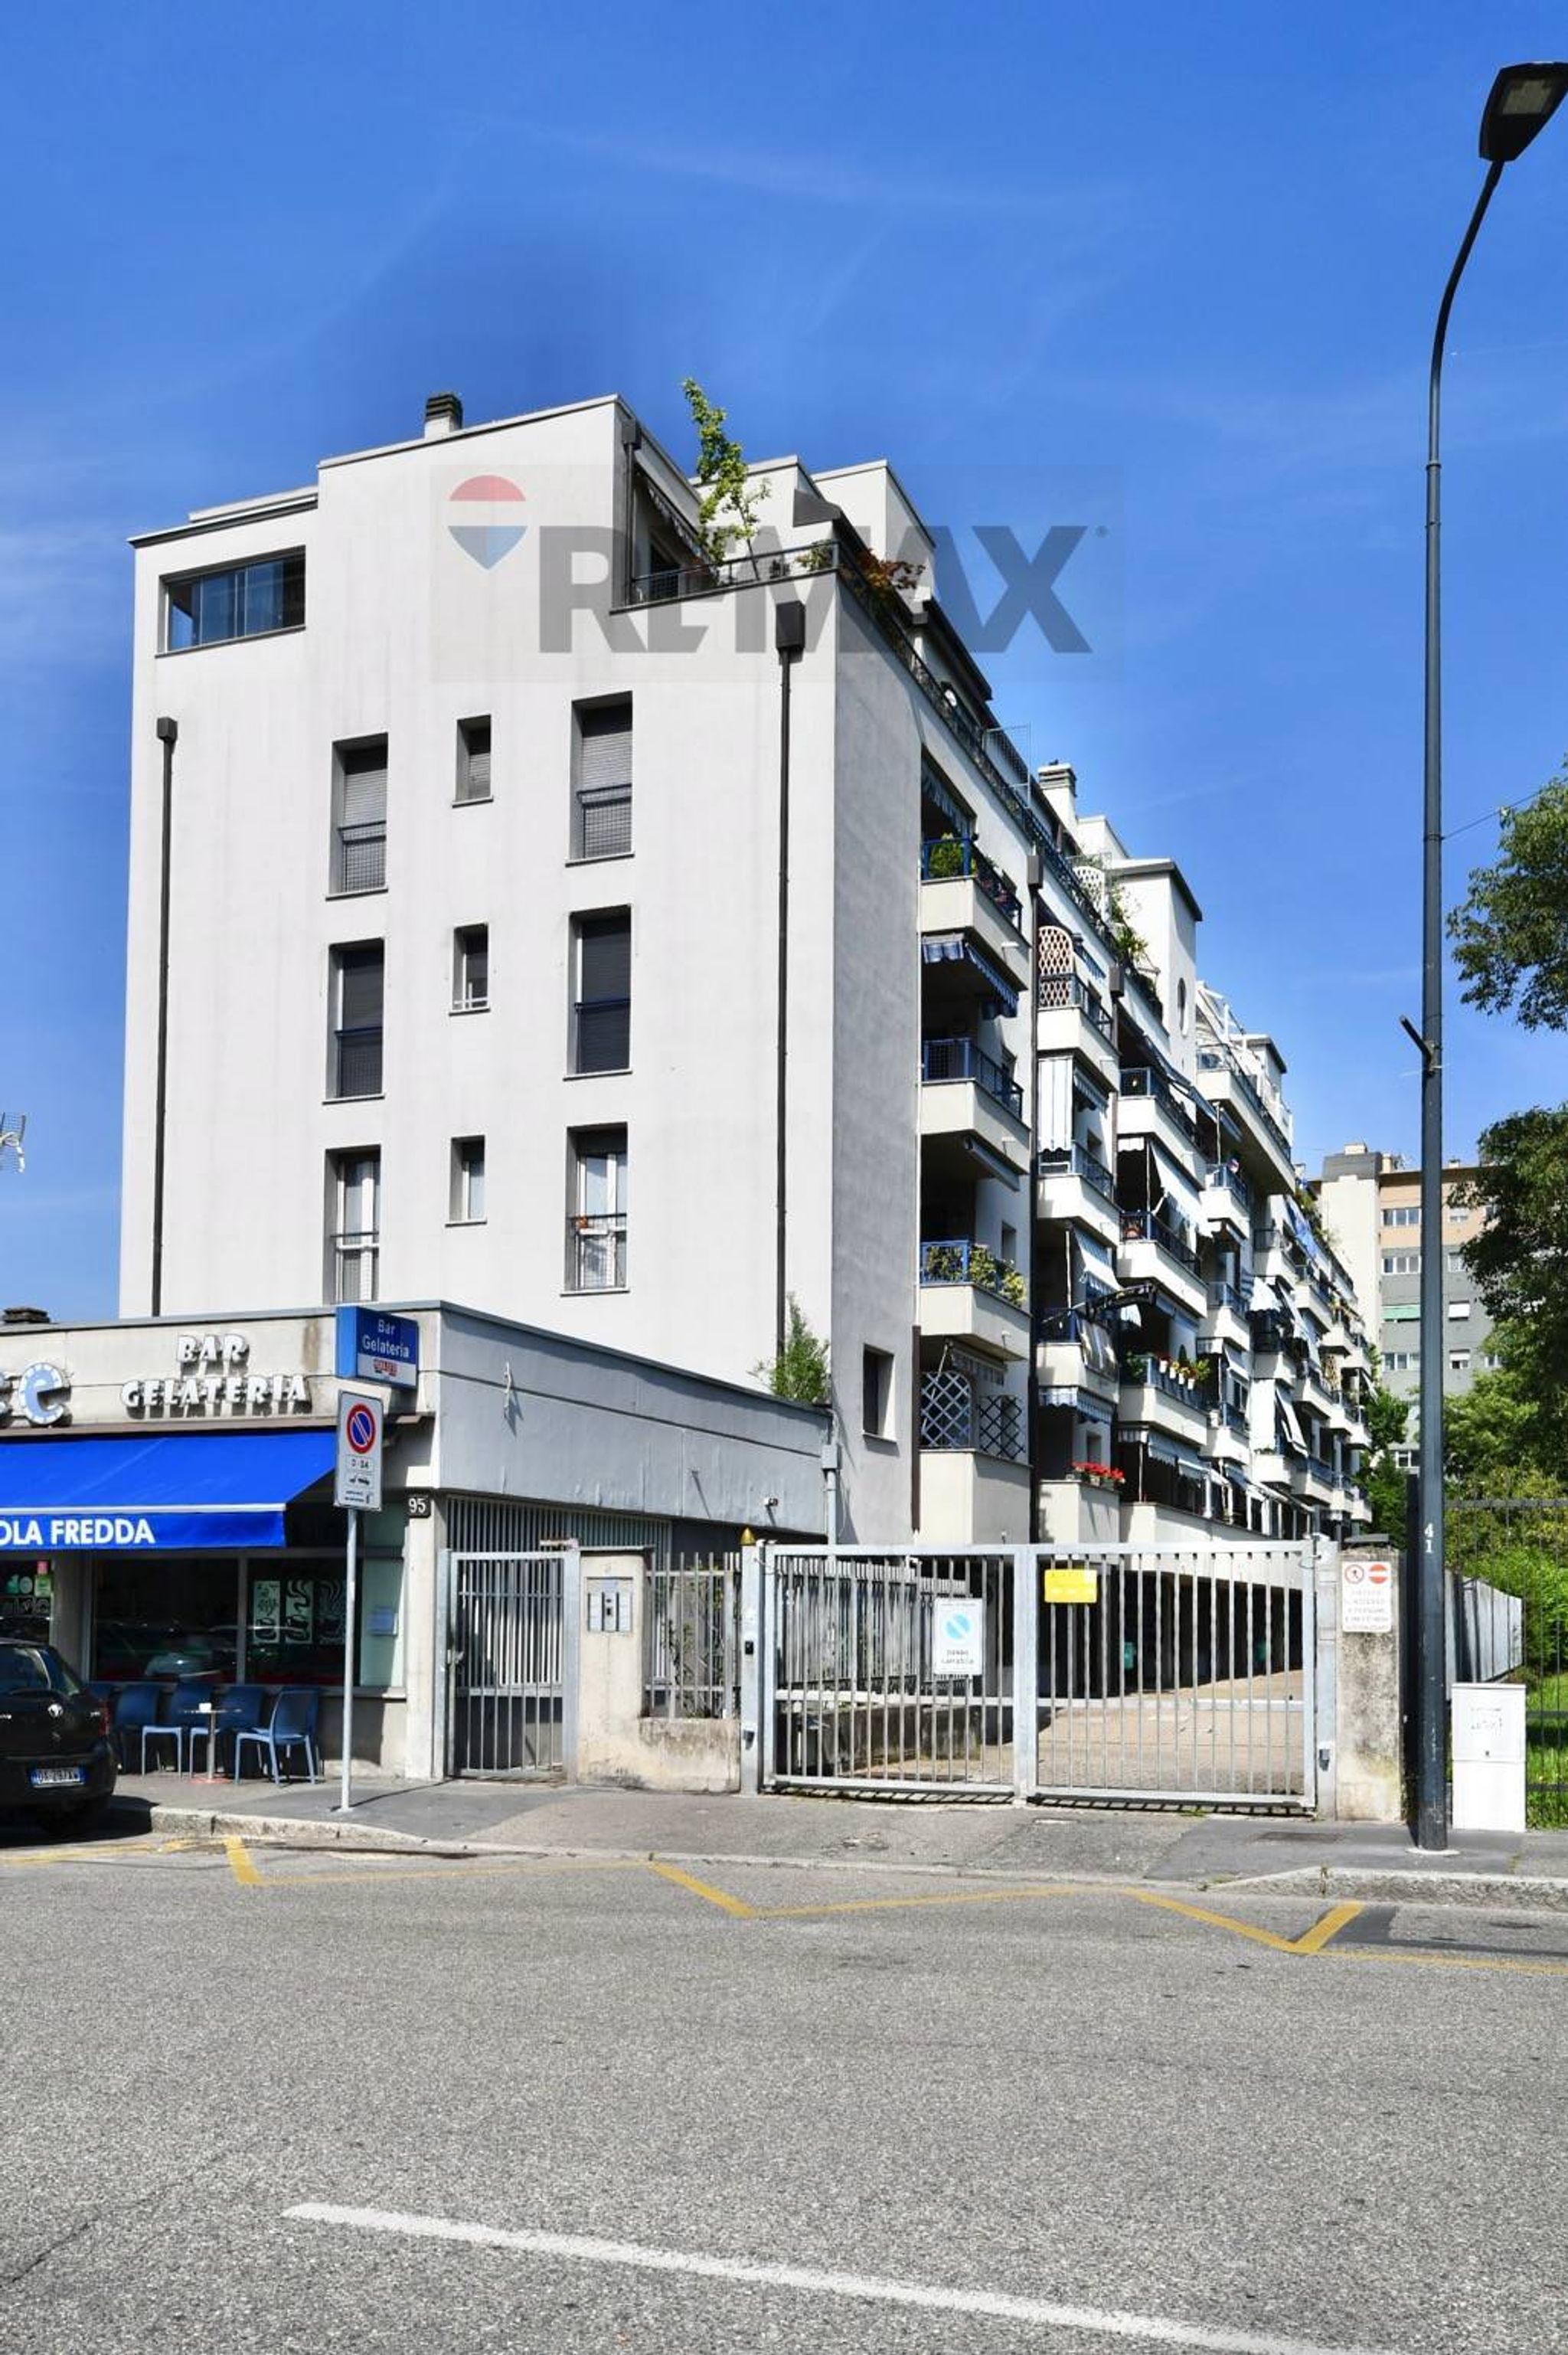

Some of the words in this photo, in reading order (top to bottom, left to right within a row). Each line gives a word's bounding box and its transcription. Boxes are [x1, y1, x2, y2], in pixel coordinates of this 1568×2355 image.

[377, 1319, 396, 1334] Bar
[177, 1335, 247, 1363] BAR
[361, 1334, 410, 1358] Gelateria
[121, 1375, 308, 1408] GELATERIA
[408, 1498, 426, 1514] 95
[51, 1518, 157, 1545] FREDDA
